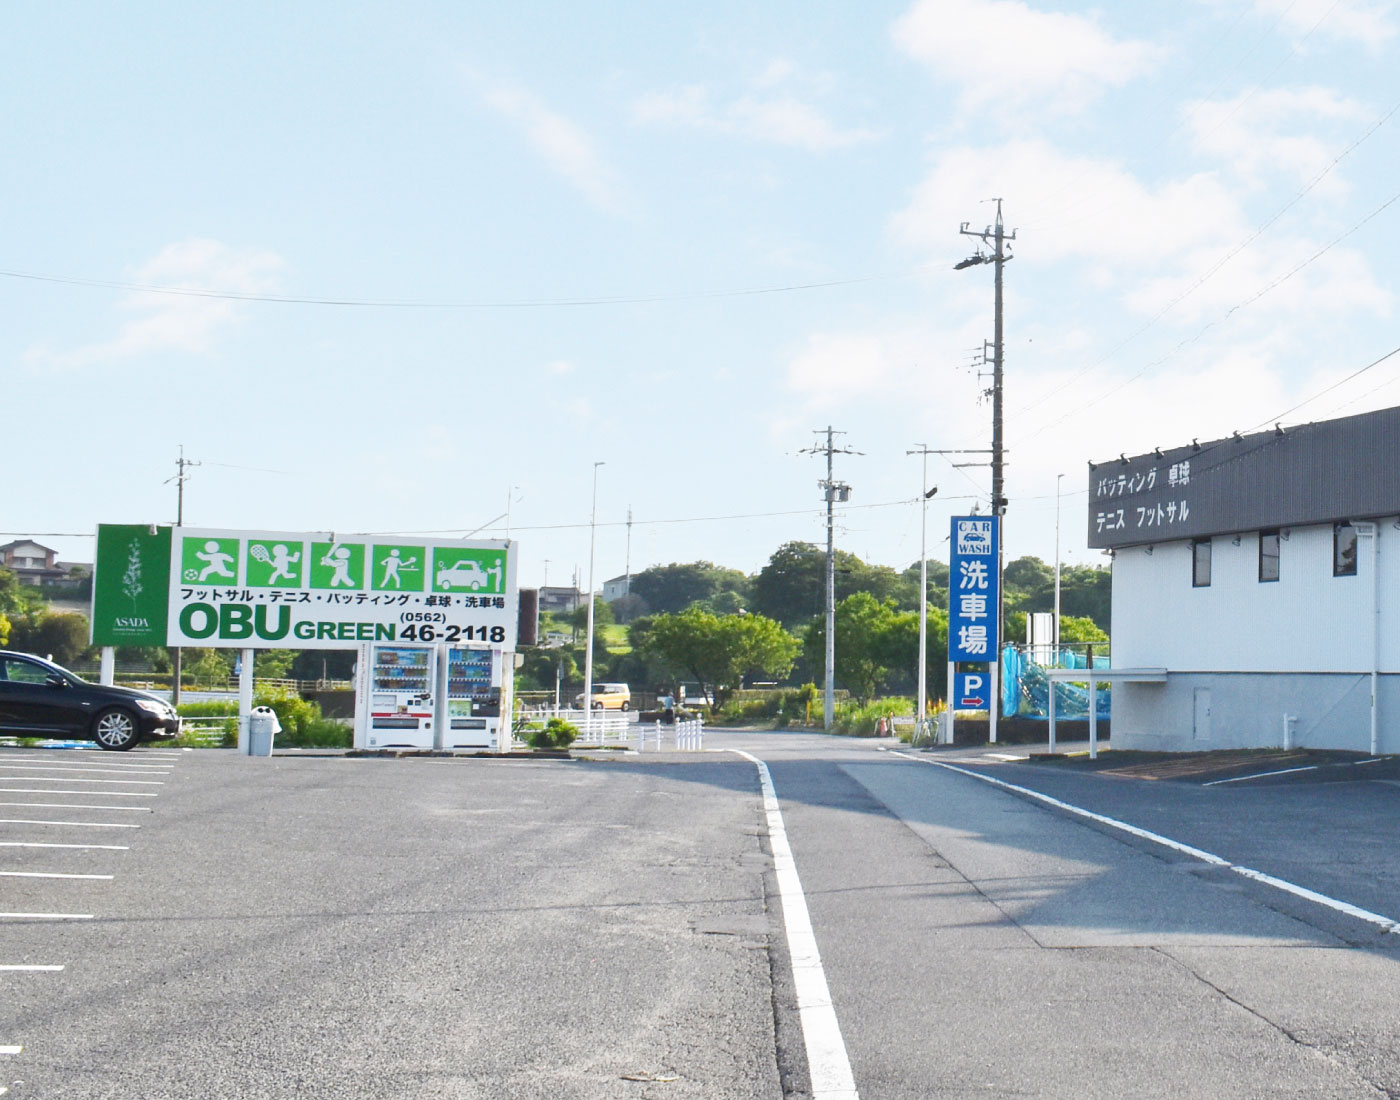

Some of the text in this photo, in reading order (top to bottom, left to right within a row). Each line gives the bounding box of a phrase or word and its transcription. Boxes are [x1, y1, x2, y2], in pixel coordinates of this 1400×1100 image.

[1168, 461, 1190, 487] 卓球
[1096, 500, 1190, 533] テニス フットサル
[958, 522, 990, 532] CAR
[958, 544, 990, 553] WASH
[958, 560, 989, 655] 洗車場
[114, 617, 149, 627] ASADA
[179, 602, 291, 641] OBU
[400, 612, 446, 624] (0562)
[294, 621, 396, 641] GREEN
[400, 624, 505, 643] 46-2118
[964, 675, 983, 695] P
